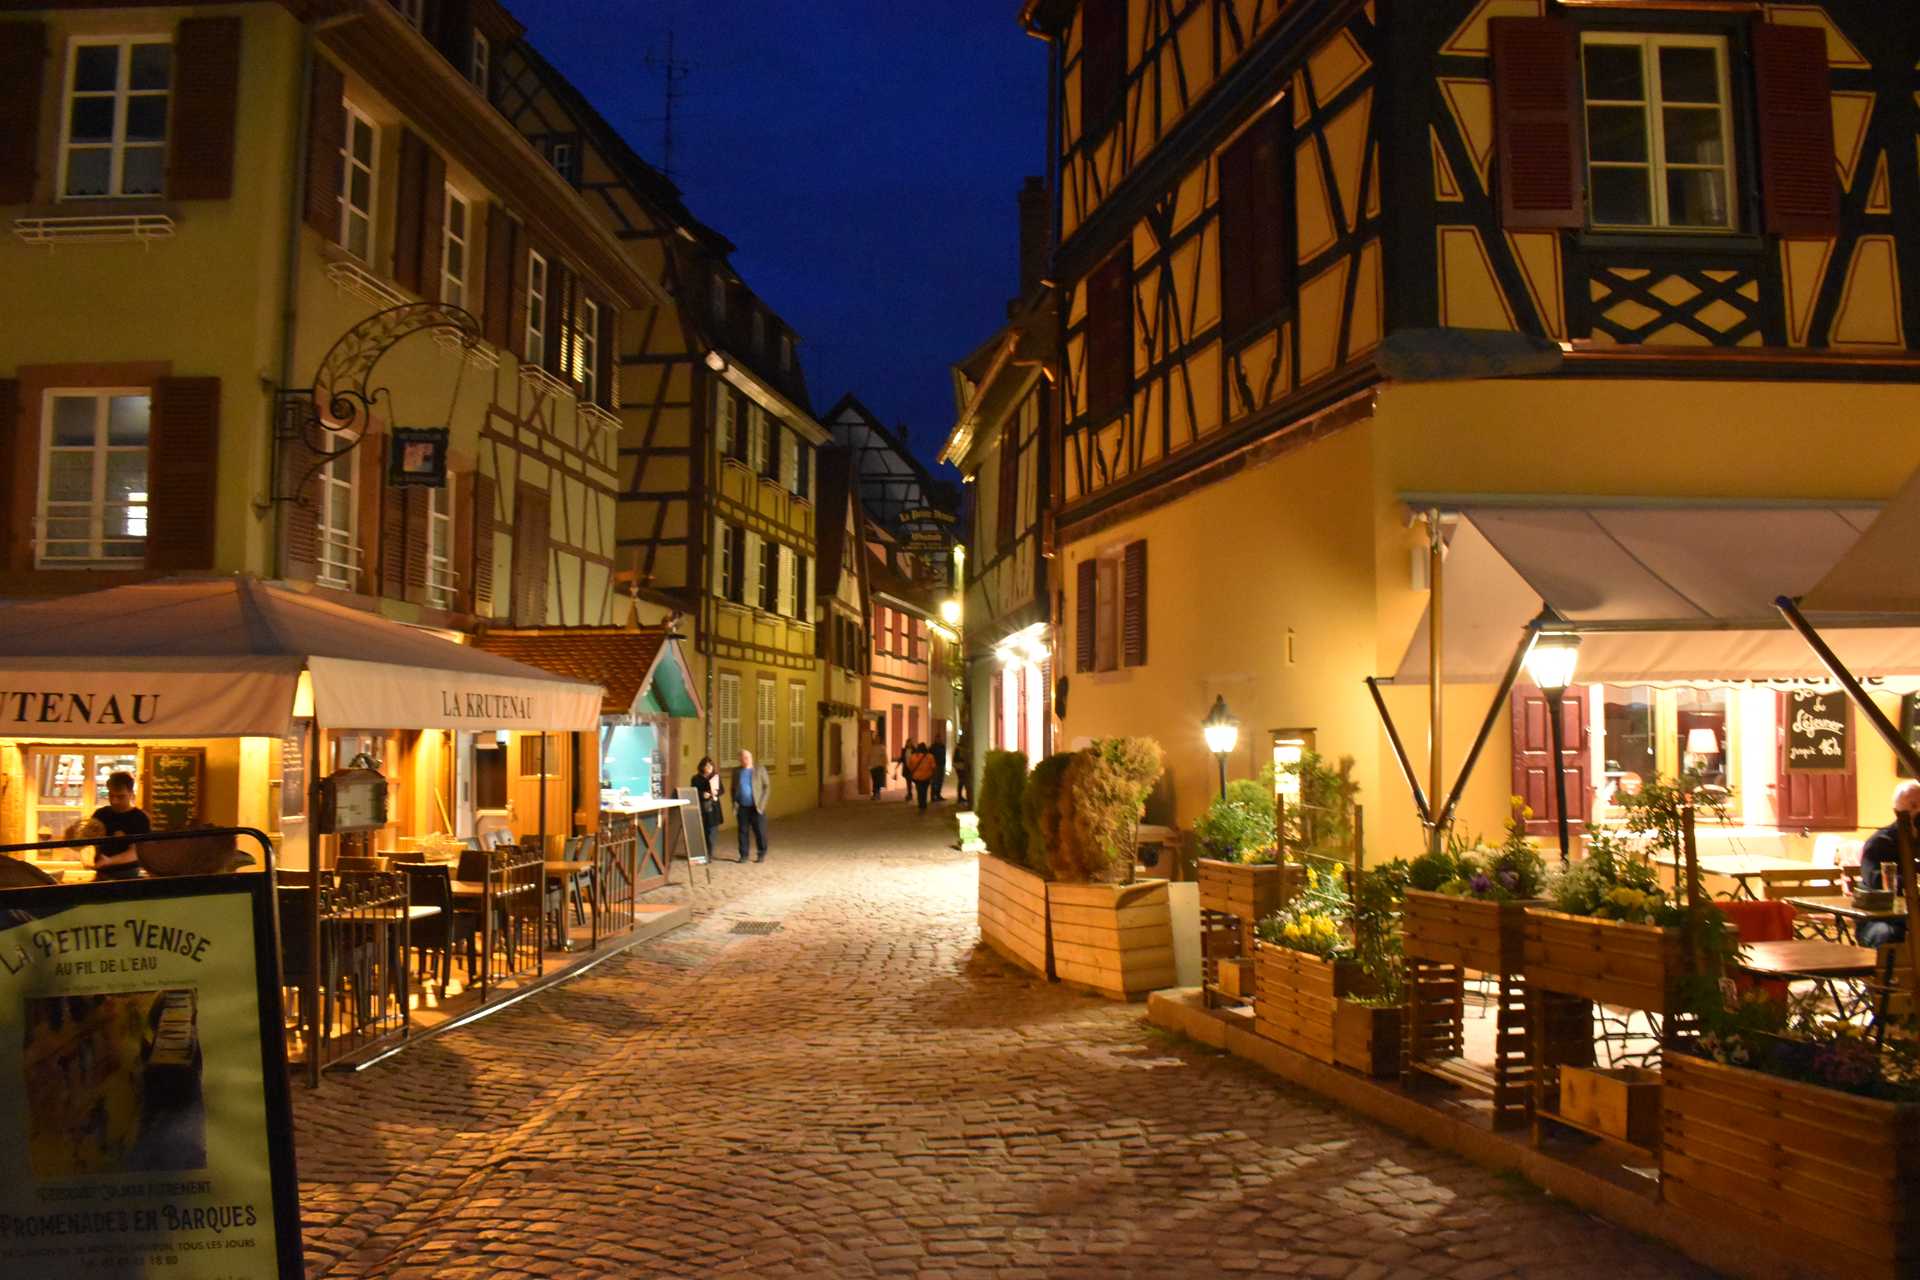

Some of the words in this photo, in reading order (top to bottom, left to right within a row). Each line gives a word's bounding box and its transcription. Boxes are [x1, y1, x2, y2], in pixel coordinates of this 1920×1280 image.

[0, 691, 160, 724] TENAU
[442, 691, 461, 717] LA
[466, 693, 534, 719] KRUTENAU
[33, 924, 118, 957] PETITE
[124, 919, 211, 962] VENISE
[56, 961, 72, 976] AU
[76, 961, 96, 975] FIL
[100, 960, 116, 973] DE
[135, 1211, 158, 1232] EN
[161, 1204, 257, 1234] BARQUES
